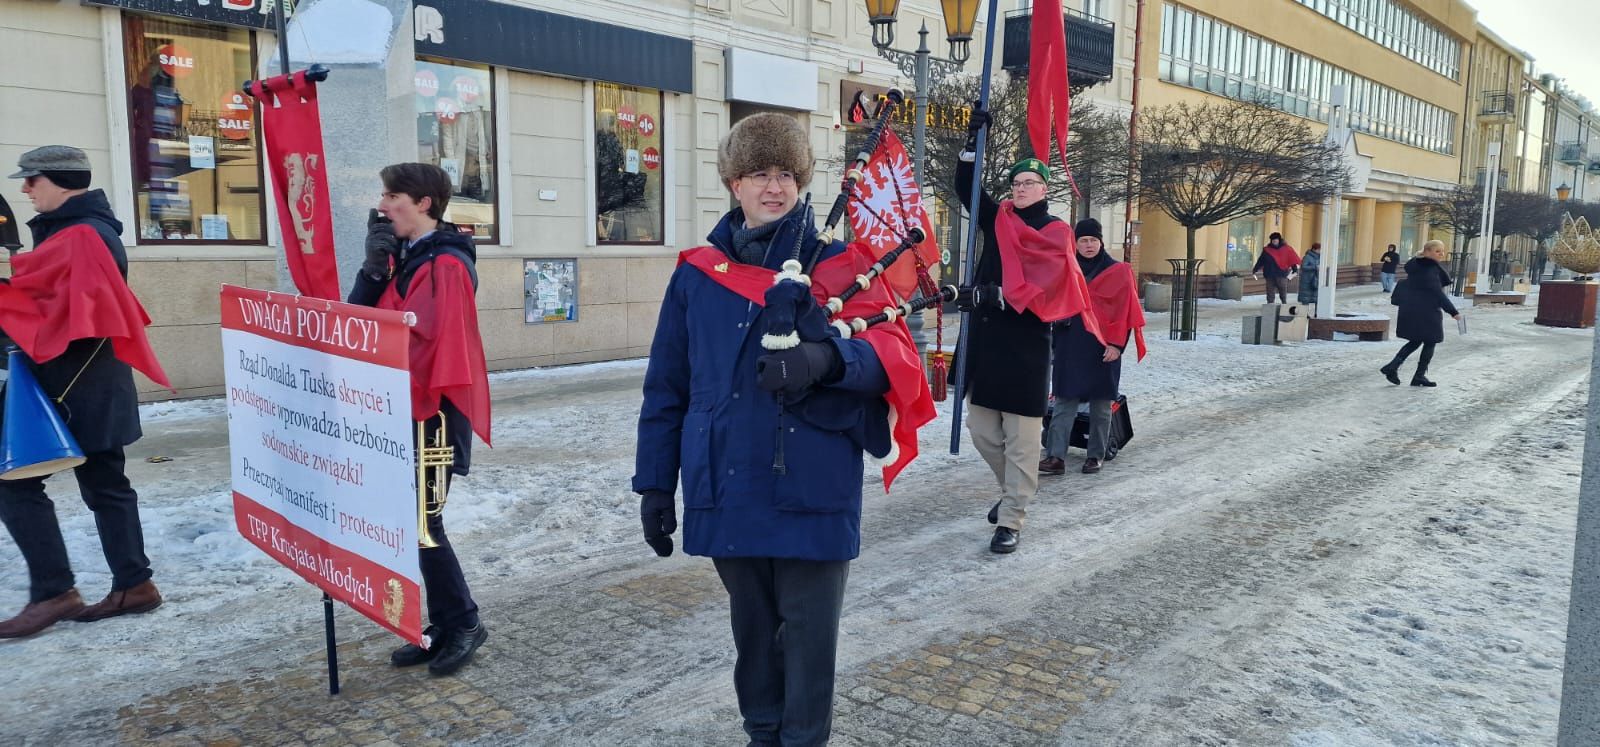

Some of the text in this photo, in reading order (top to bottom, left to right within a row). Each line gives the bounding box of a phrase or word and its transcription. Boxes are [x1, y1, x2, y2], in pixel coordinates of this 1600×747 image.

[160, 54, 193, 68] SALE
[414, 77, 439, 89] SALE
[456, 82, 480, 94] SALE
[218, 118, 250, 130] SALE
[617, 112, 636, 122] SALE
[643, 153, 660, 162] SALE
[239, 296, 380, 354] UWAGA POLACY!
[239, 349, 393, 415] Rząd Donalda Tuska skrycie i
[231, 384, 410, 466] podstępnie wprowadza bezbożne,
[262, 430, 364, 486] sodomskie związki!
[243, 457, 405, 557] Przeczytaj manifest i protestuj!
[247, 513, 374, 606] TFP Krucjata Młodych
